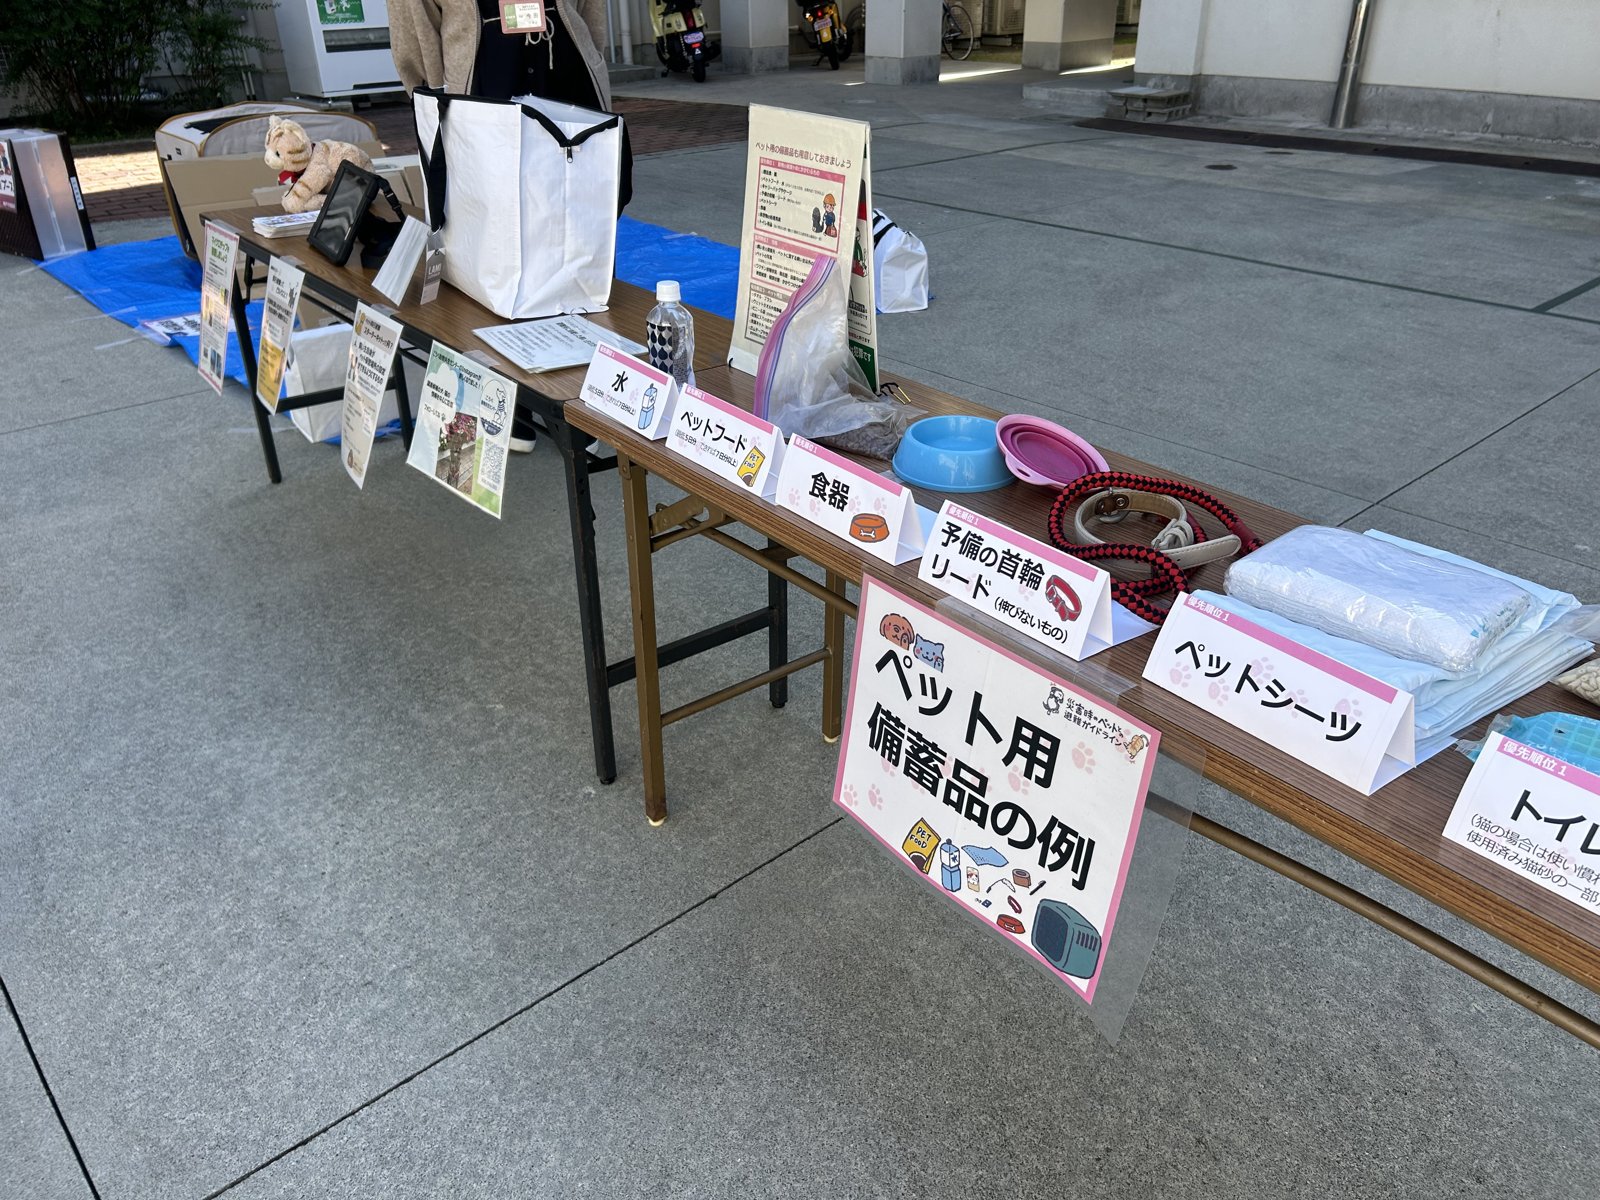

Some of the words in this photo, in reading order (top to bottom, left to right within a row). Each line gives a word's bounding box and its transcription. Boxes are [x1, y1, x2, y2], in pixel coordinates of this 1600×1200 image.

[611, 370, 629, 393] 水
[680, 411, 748, 454] ペットフード
[808, 471, 851, 513] 食器
[931, 553, 993, 600] リード
[940, 520, 1045, 592] 予備の首輪
[1174, 640, 1363, 742] ペットシーツ
[874, 646, 1062, 789] ペット用
[867, 700, 1097, 891] 備蓄品の例
[909, 834, 928, 849] FOOD
[916, 826, 932, 842] PET
